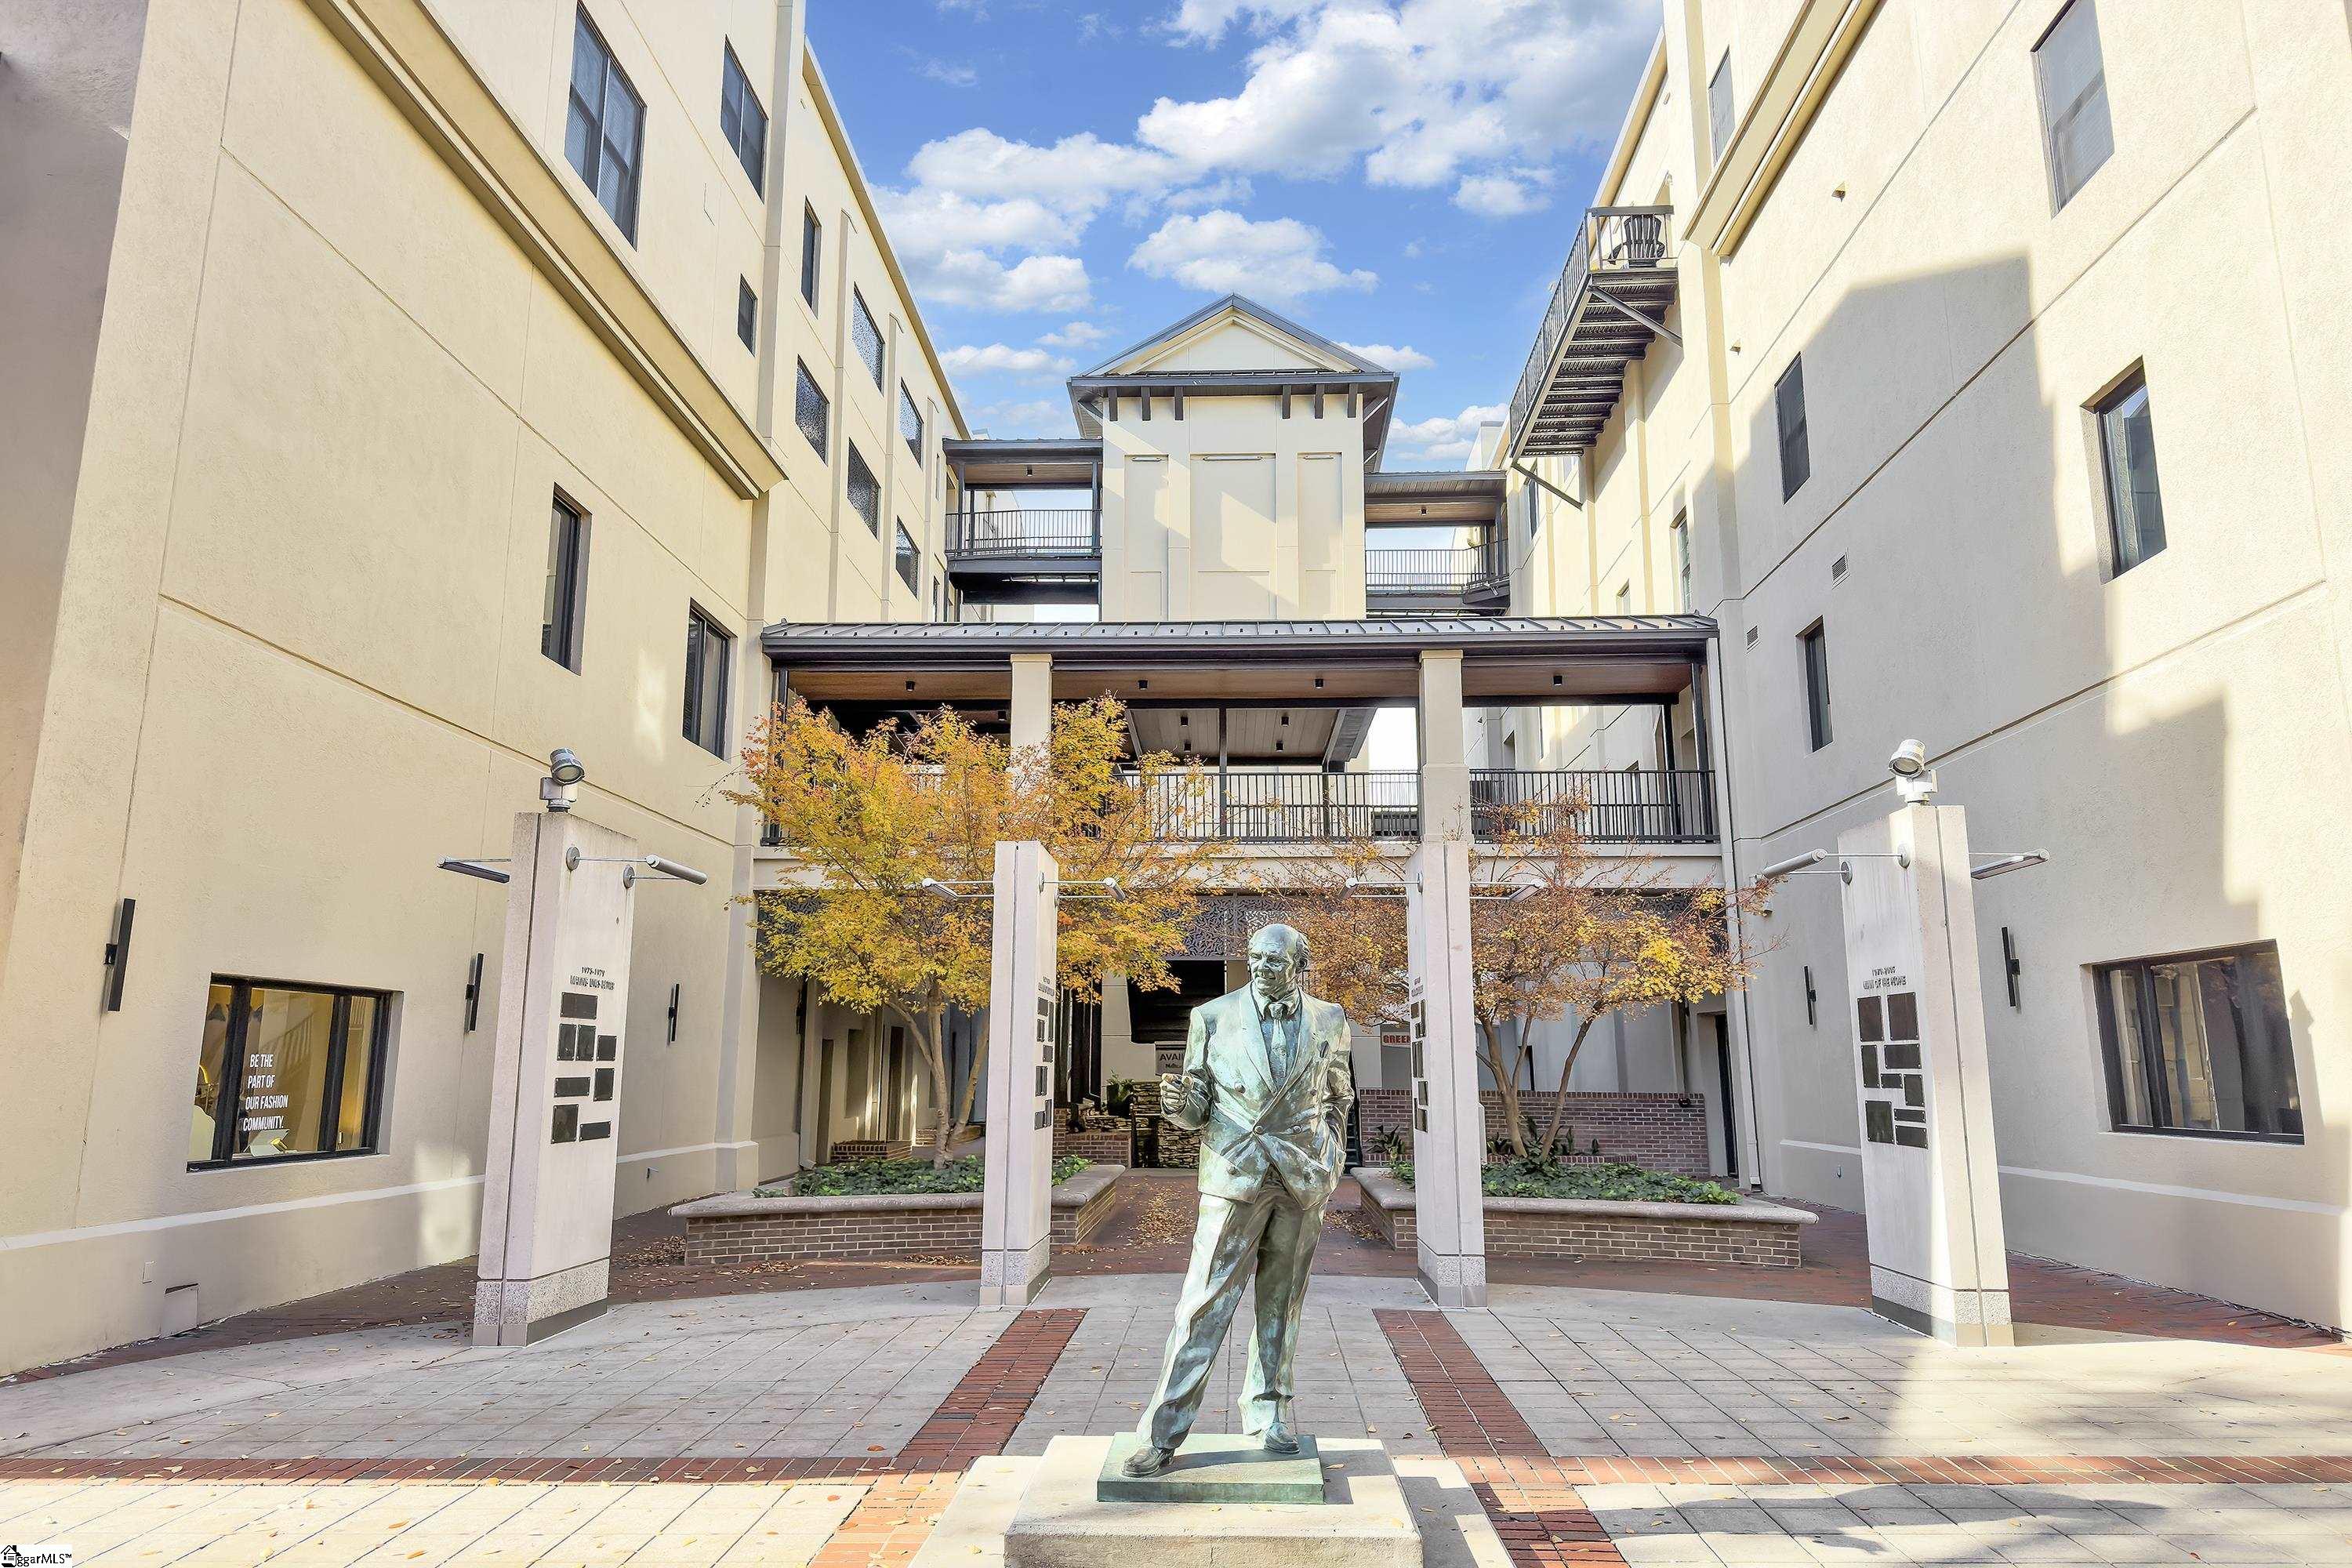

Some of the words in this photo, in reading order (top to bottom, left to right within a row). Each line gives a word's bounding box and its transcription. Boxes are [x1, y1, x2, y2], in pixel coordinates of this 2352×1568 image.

[249, 1054, 260, 1067] BE
[260, 1054, 274, 1067] THE
[247, 1075, 266, 1088] PART
[267, 1074, 276, 1087] OF
[245, 1096, 260, 1110] OUR
[260, 1095, 289, 1109] FASHION
[243, 1116, 284, 1131] COMMUNITY.
